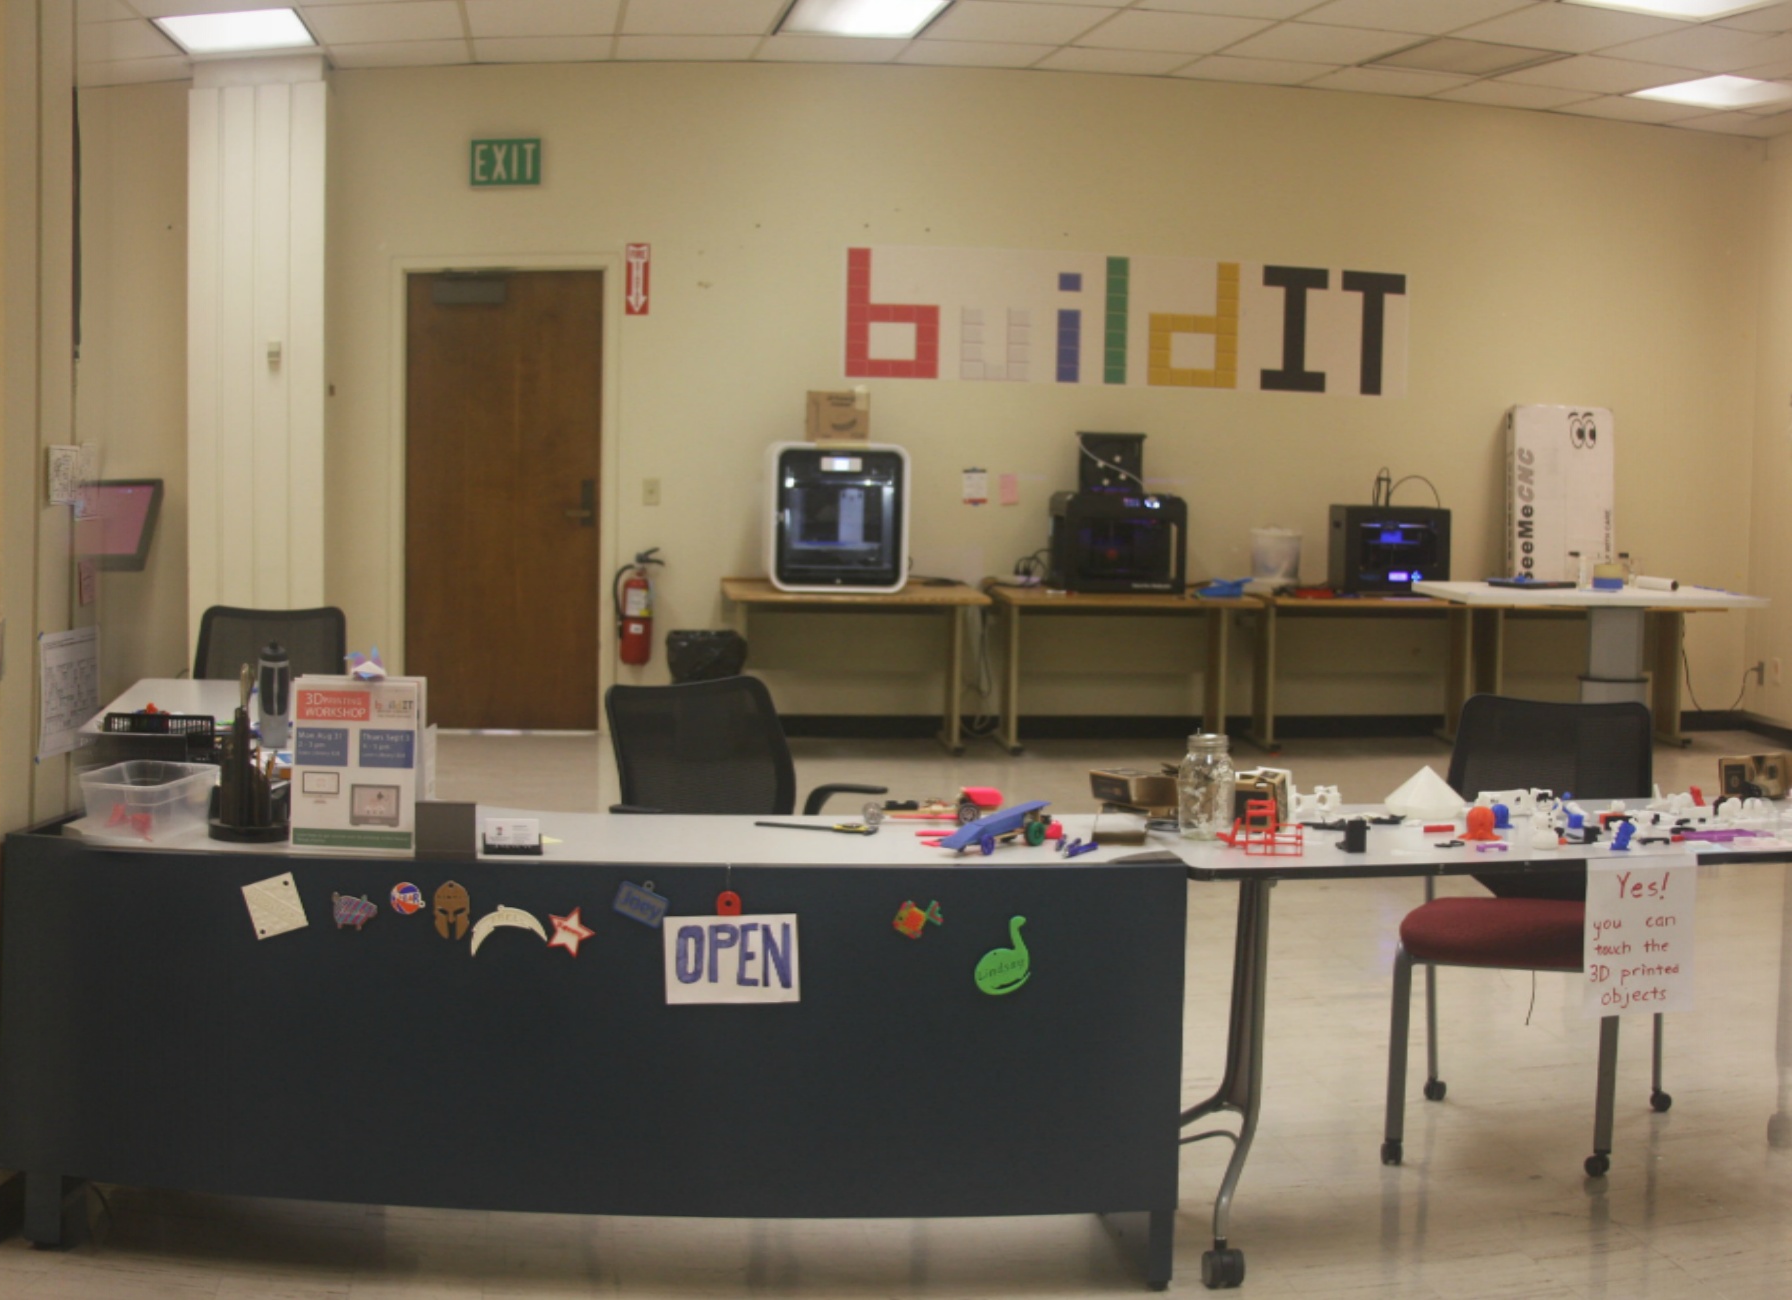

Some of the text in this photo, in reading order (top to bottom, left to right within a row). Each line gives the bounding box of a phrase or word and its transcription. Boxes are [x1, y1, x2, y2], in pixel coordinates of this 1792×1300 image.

[474, 144, 536, 181] EXIT
[845, 246, 1406, 397] buildIT
[306, 706, 366, 718] WORKSHOP
[1616, 871, 1670, 900] Yes!
[622, 890, 662, 920] Joey
[1593, 915, 1676, 941] you can
[675, 922, 792, 989] OPEN
[1594, 938, 1669, 956] touch the
[1589, 963, 1679, 986] 3D printed
[1601, 987, 1667, 1009] objects
